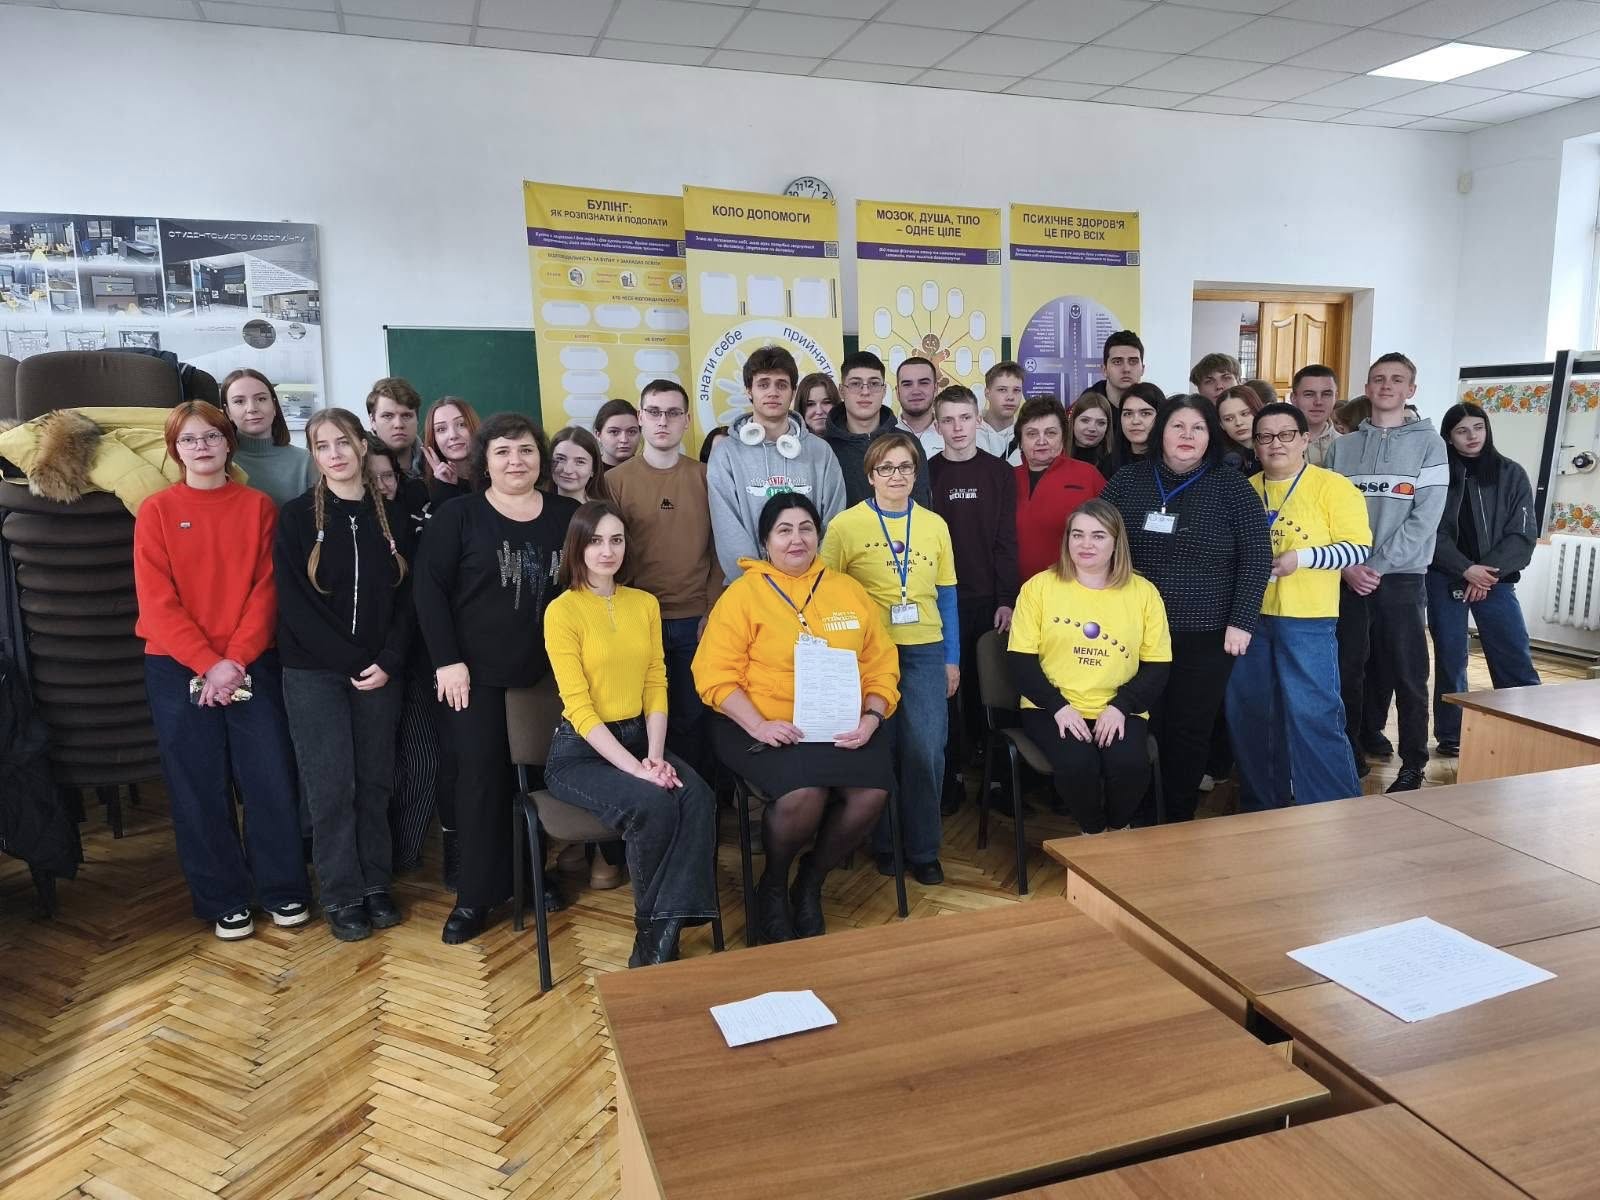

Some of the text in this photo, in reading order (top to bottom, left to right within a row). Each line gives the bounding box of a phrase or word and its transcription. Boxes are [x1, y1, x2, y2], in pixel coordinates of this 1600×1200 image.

[795, 182, 804, 191] 11
[803, 180, 814, 189] 12
[816, 183, 821, 192] 1
[822, 191, 829, 200] 2
[587, 199, 632, 214] БУЛІНГ:
[550, 209, 668, 227] ЯК РОЗПІЗНАТИ Й ПОДОЛАТИ
[712, 205, 811, 224] КОЛО ДОПОМОГИ
[876, 209, 981, 226] МОЗОК, ДУША, ТІЛО
[1023, 213, 1125, 229] ПСИХІЧНЕ ЗДОРОВ'Я
[905, 225, 934, 236] ОДНЕ
[937, 227, 961, 238] ЦІЛЕ
[1044, 228, 1105, 240] ЦЕ ПРО ВСІХ
[783, 327, 834, 379] прийняти
[700, 329, 743, 401] знати себе
[1270, 529, 1286, 537] TAL
[1073, 646, 1110, 657] MENTAL
[1077, 657, 1103, 667] TREK
